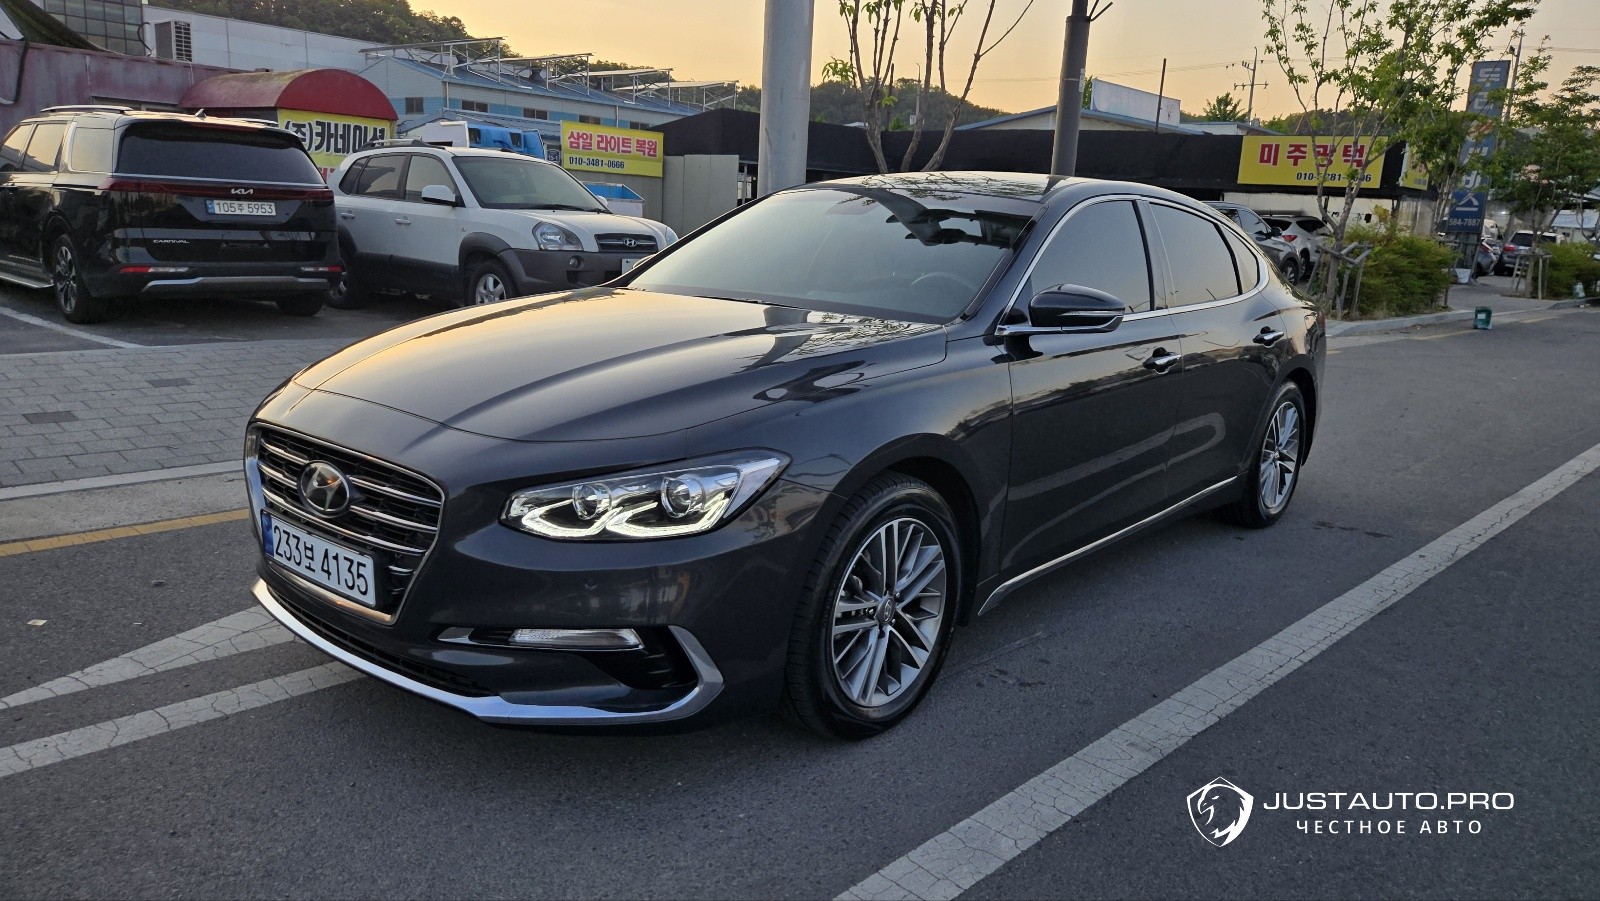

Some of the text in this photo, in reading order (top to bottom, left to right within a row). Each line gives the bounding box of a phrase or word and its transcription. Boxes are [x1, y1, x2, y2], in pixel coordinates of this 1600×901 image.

[285, 120, 386, 155] 주)카네이션
[568, 131, 658, 158] 삼일 라이트 복원
[569, 156, 625, 169] 010-3481-0666
[216, 202, 274, 215] 105주 5953
[273, 524, 369, 597] 233보 4135
